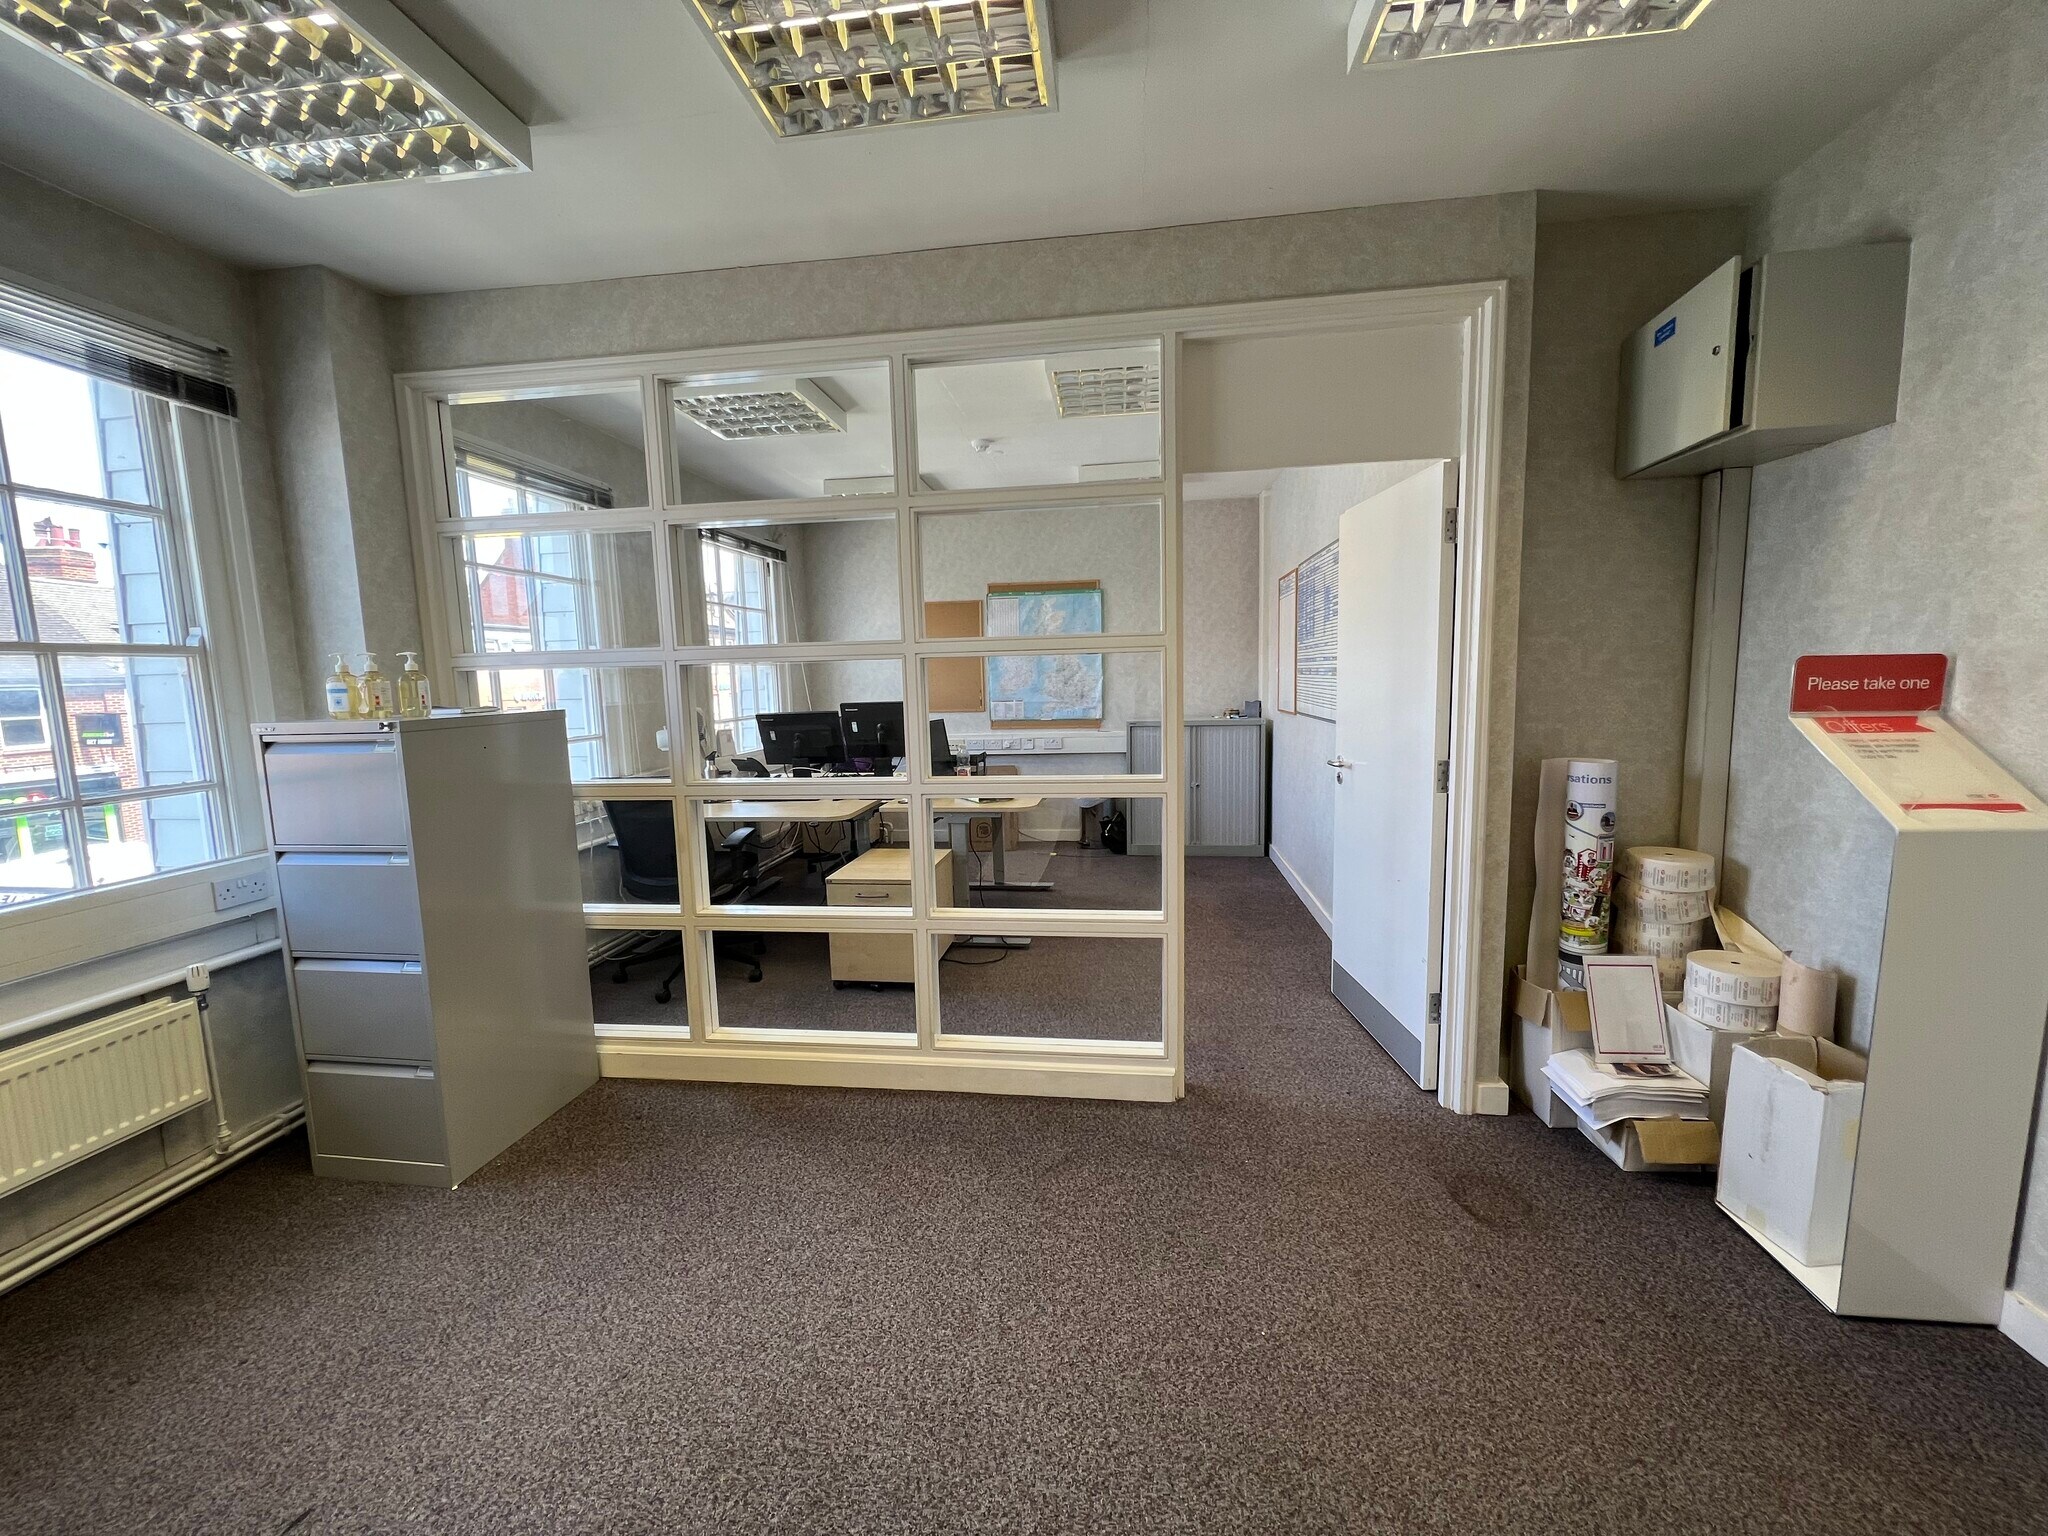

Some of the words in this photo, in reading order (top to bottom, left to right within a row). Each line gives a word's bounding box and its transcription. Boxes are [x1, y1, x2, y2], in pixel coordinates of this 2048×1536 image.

[1807, 676, 1859, 691] Please
[1863, 675, 1896, 690] take
[1899, 678, 1930, 690] one
[1825, 720, 1894, 732] Offers
